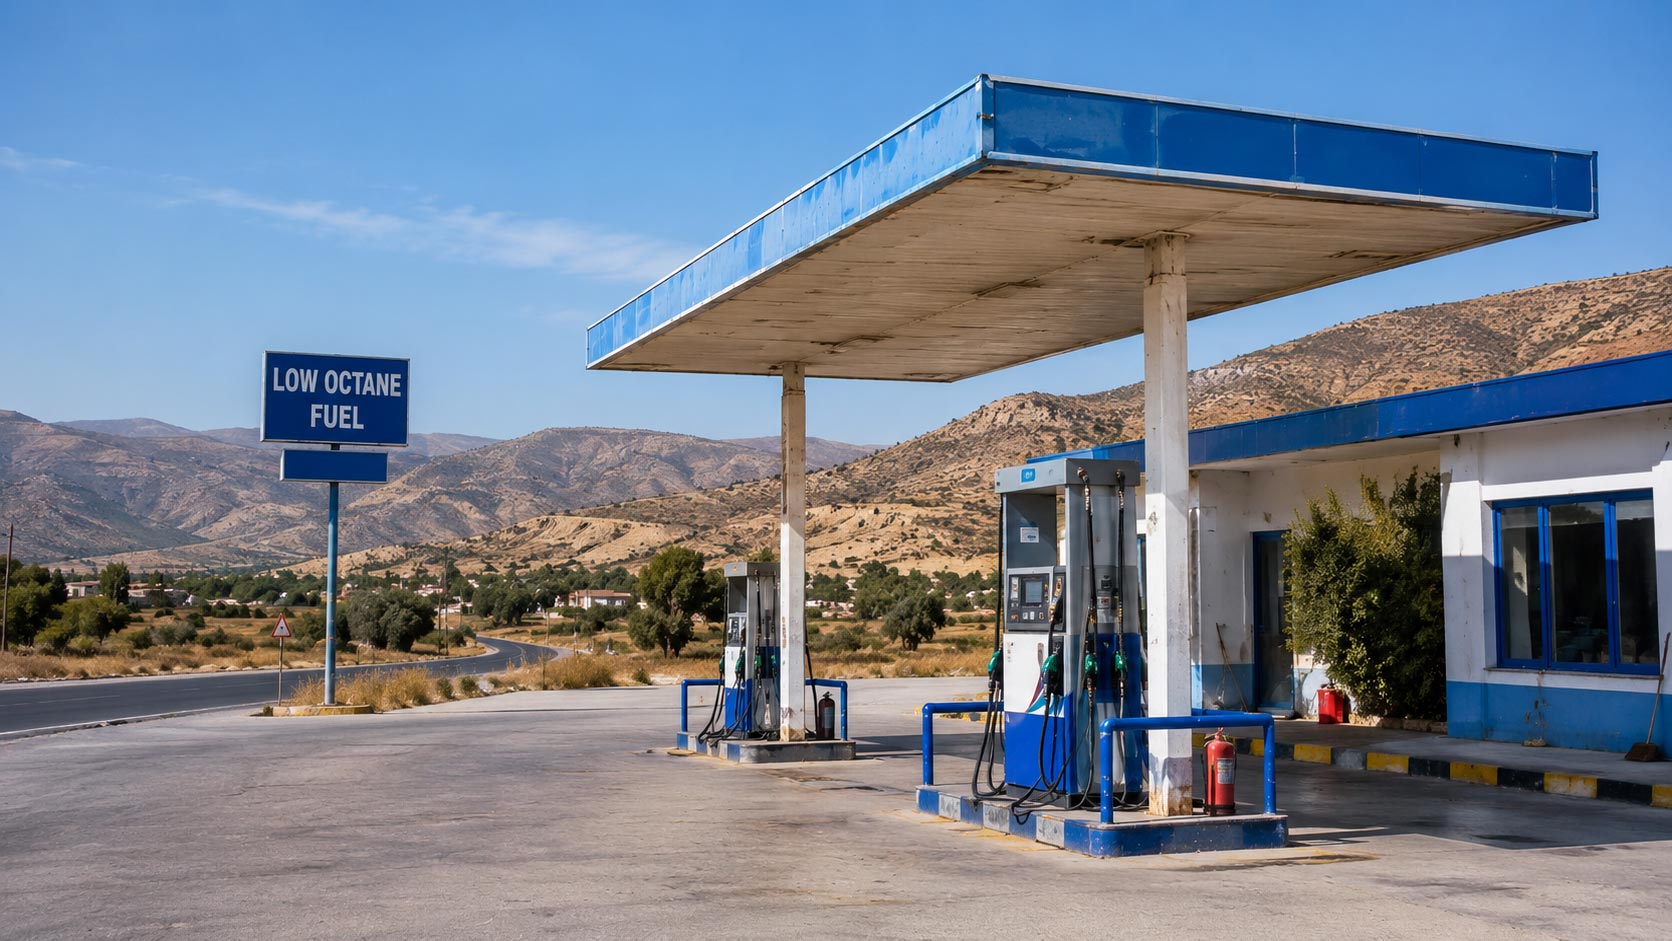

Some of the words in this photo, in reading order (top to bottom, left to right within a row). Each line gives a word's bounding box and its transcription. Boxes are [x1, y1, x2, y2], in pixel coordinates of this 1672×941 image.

[273, 367, 319, 393] LOW
[324, 369, 402, 397] OCTANE
[310, 403, 365, 430] FUEL
